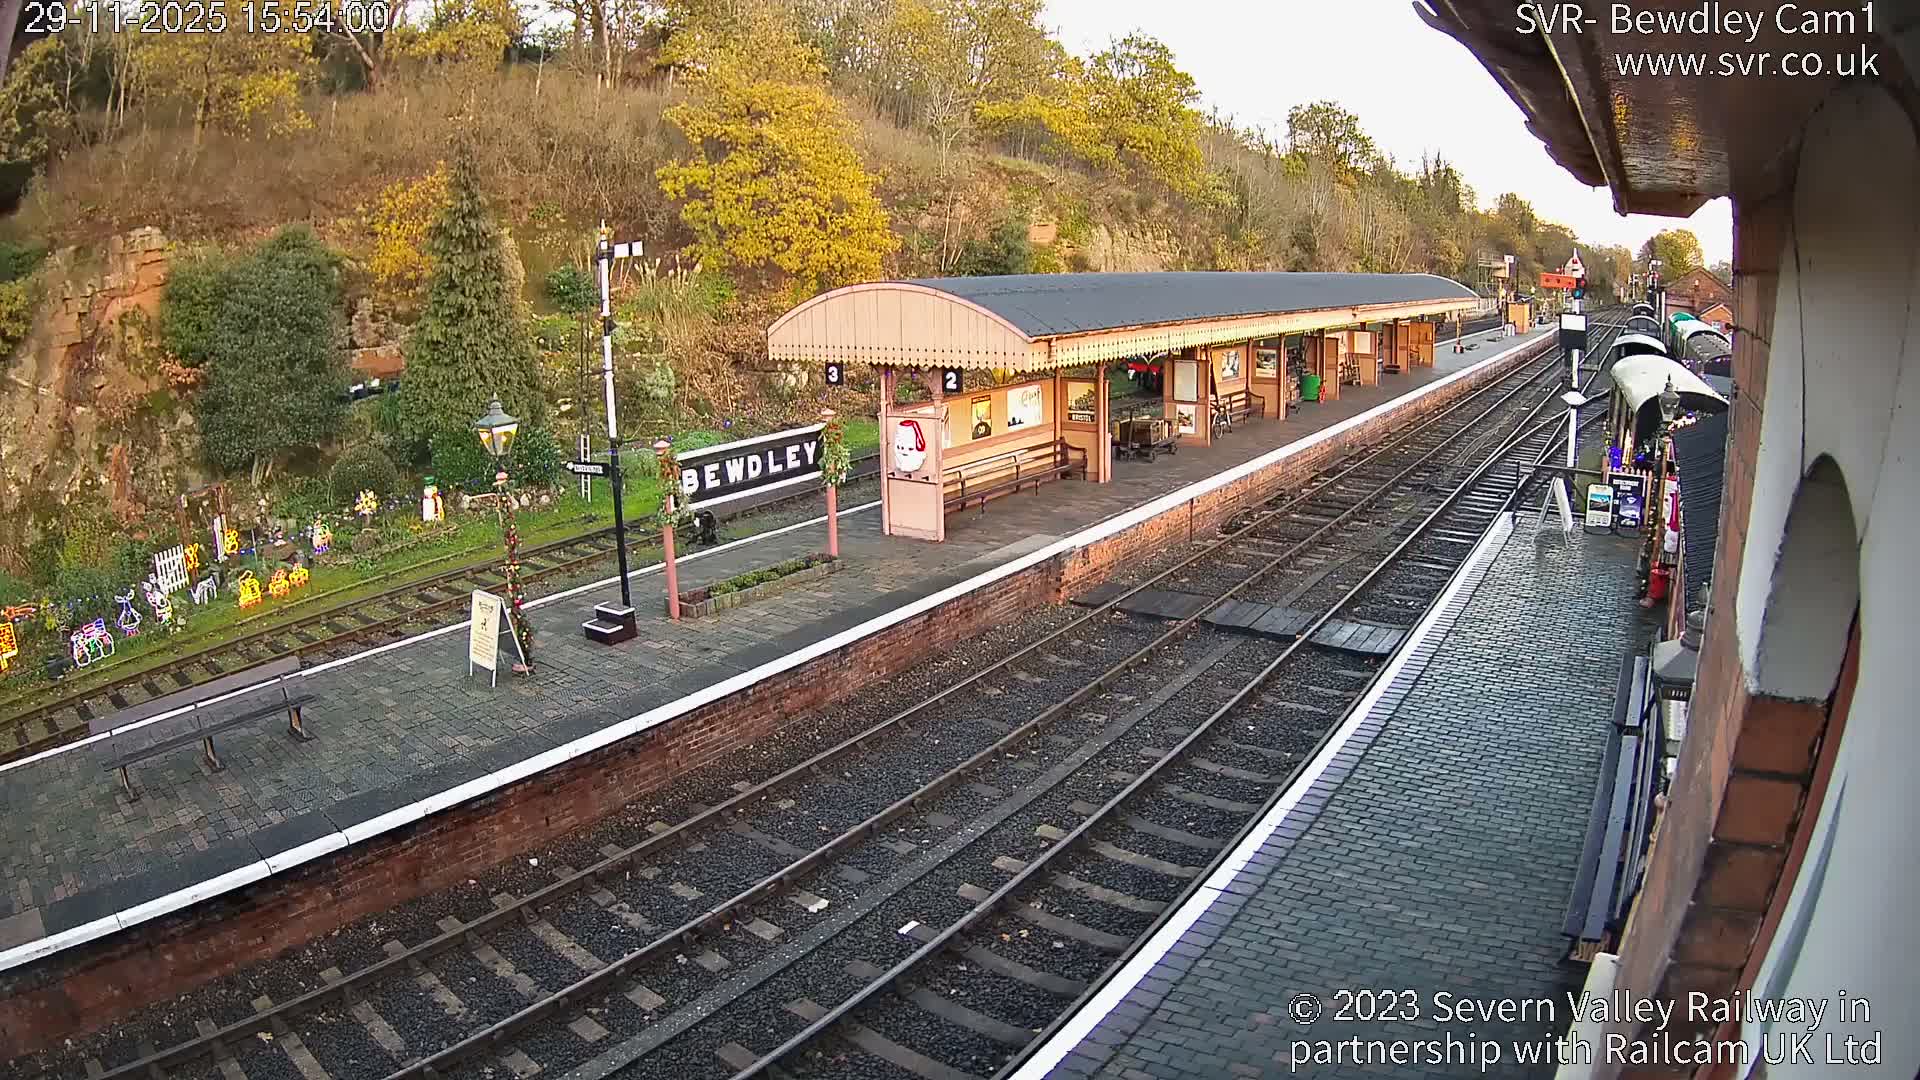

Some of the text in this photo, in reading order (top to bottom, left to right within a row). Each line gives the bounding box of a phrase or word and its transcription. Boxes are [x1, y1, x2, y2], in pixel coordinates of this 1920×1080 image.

[828, 366, 839, 382] 3
[945, 372, 957, 389] 2
[681, 441, 817, 495] BEWDLEY
